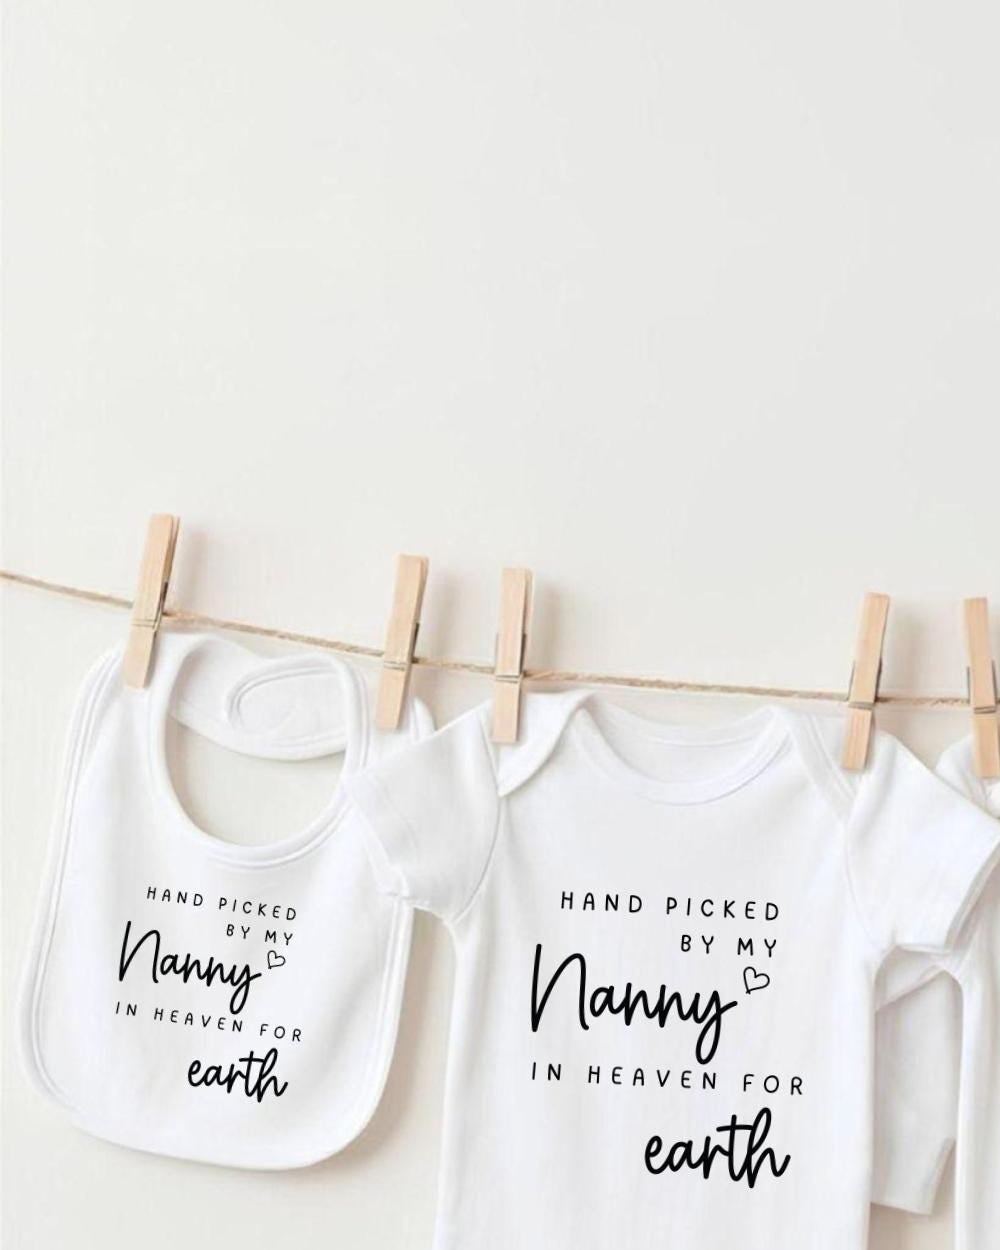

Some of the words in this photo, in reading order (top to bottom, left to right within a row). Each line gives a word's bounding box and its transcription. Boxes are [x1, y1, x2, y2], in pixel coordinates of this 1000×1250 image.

[146, 886, 204, 907] HAND
[218, 896, 297, 921] PICKED
[560, 890, 643, 914] HAND
[666, 896, 779, 922] PICKED
[226, 923, 251, 940] BY
[264, 929, 294, 946] MY
[680, 934, 715, 955] BY
[736, 937, 777, 958] MY
[118, 920, 263, 1016] Nanny
[115, 1001, 138, 1017] IN
[153, 1007, 243, 1033] HEAVEN
[259, 1023, 302, 1042] FOR
[530, 943, 739, 1066] Nanny
[187, 1047, 289, 1104] earth
[531, 1061, 562, 1081] IN
[587, 1065, 717, 1090] HEAVEN
[742, 1073, 803, 1096] FOR
[644, 1106, 792, 1189] earth
